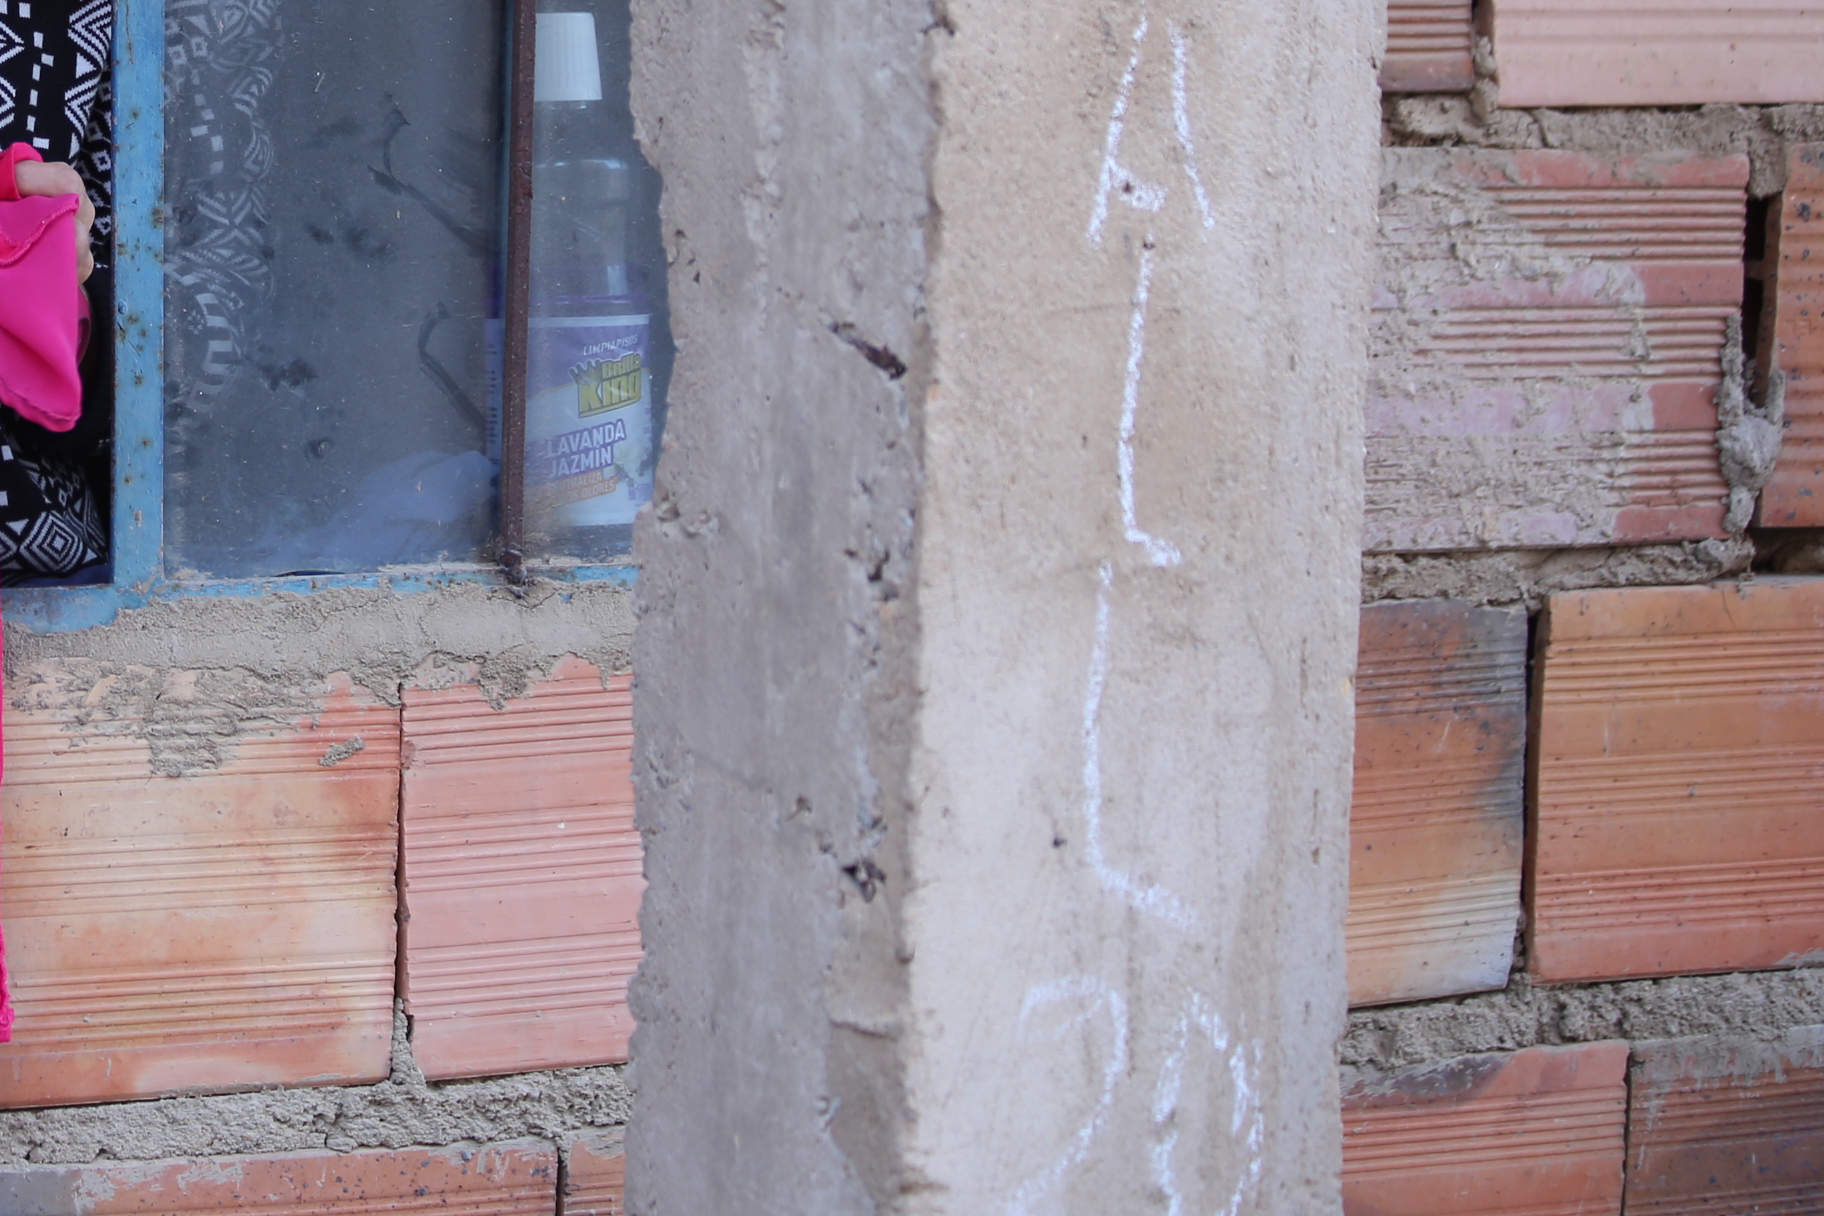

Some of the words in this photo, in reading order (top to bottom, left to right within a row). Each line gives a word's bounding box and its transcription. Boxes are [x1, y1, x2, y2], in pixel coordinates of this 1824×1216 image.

[583, 333, 639, 356] LIMPIAPISOS
[546, 420, 626, 457] LAVANDA
[548, 444, 613, 479] JAZMÍN
[581, 479, 615, 499] OLORES
